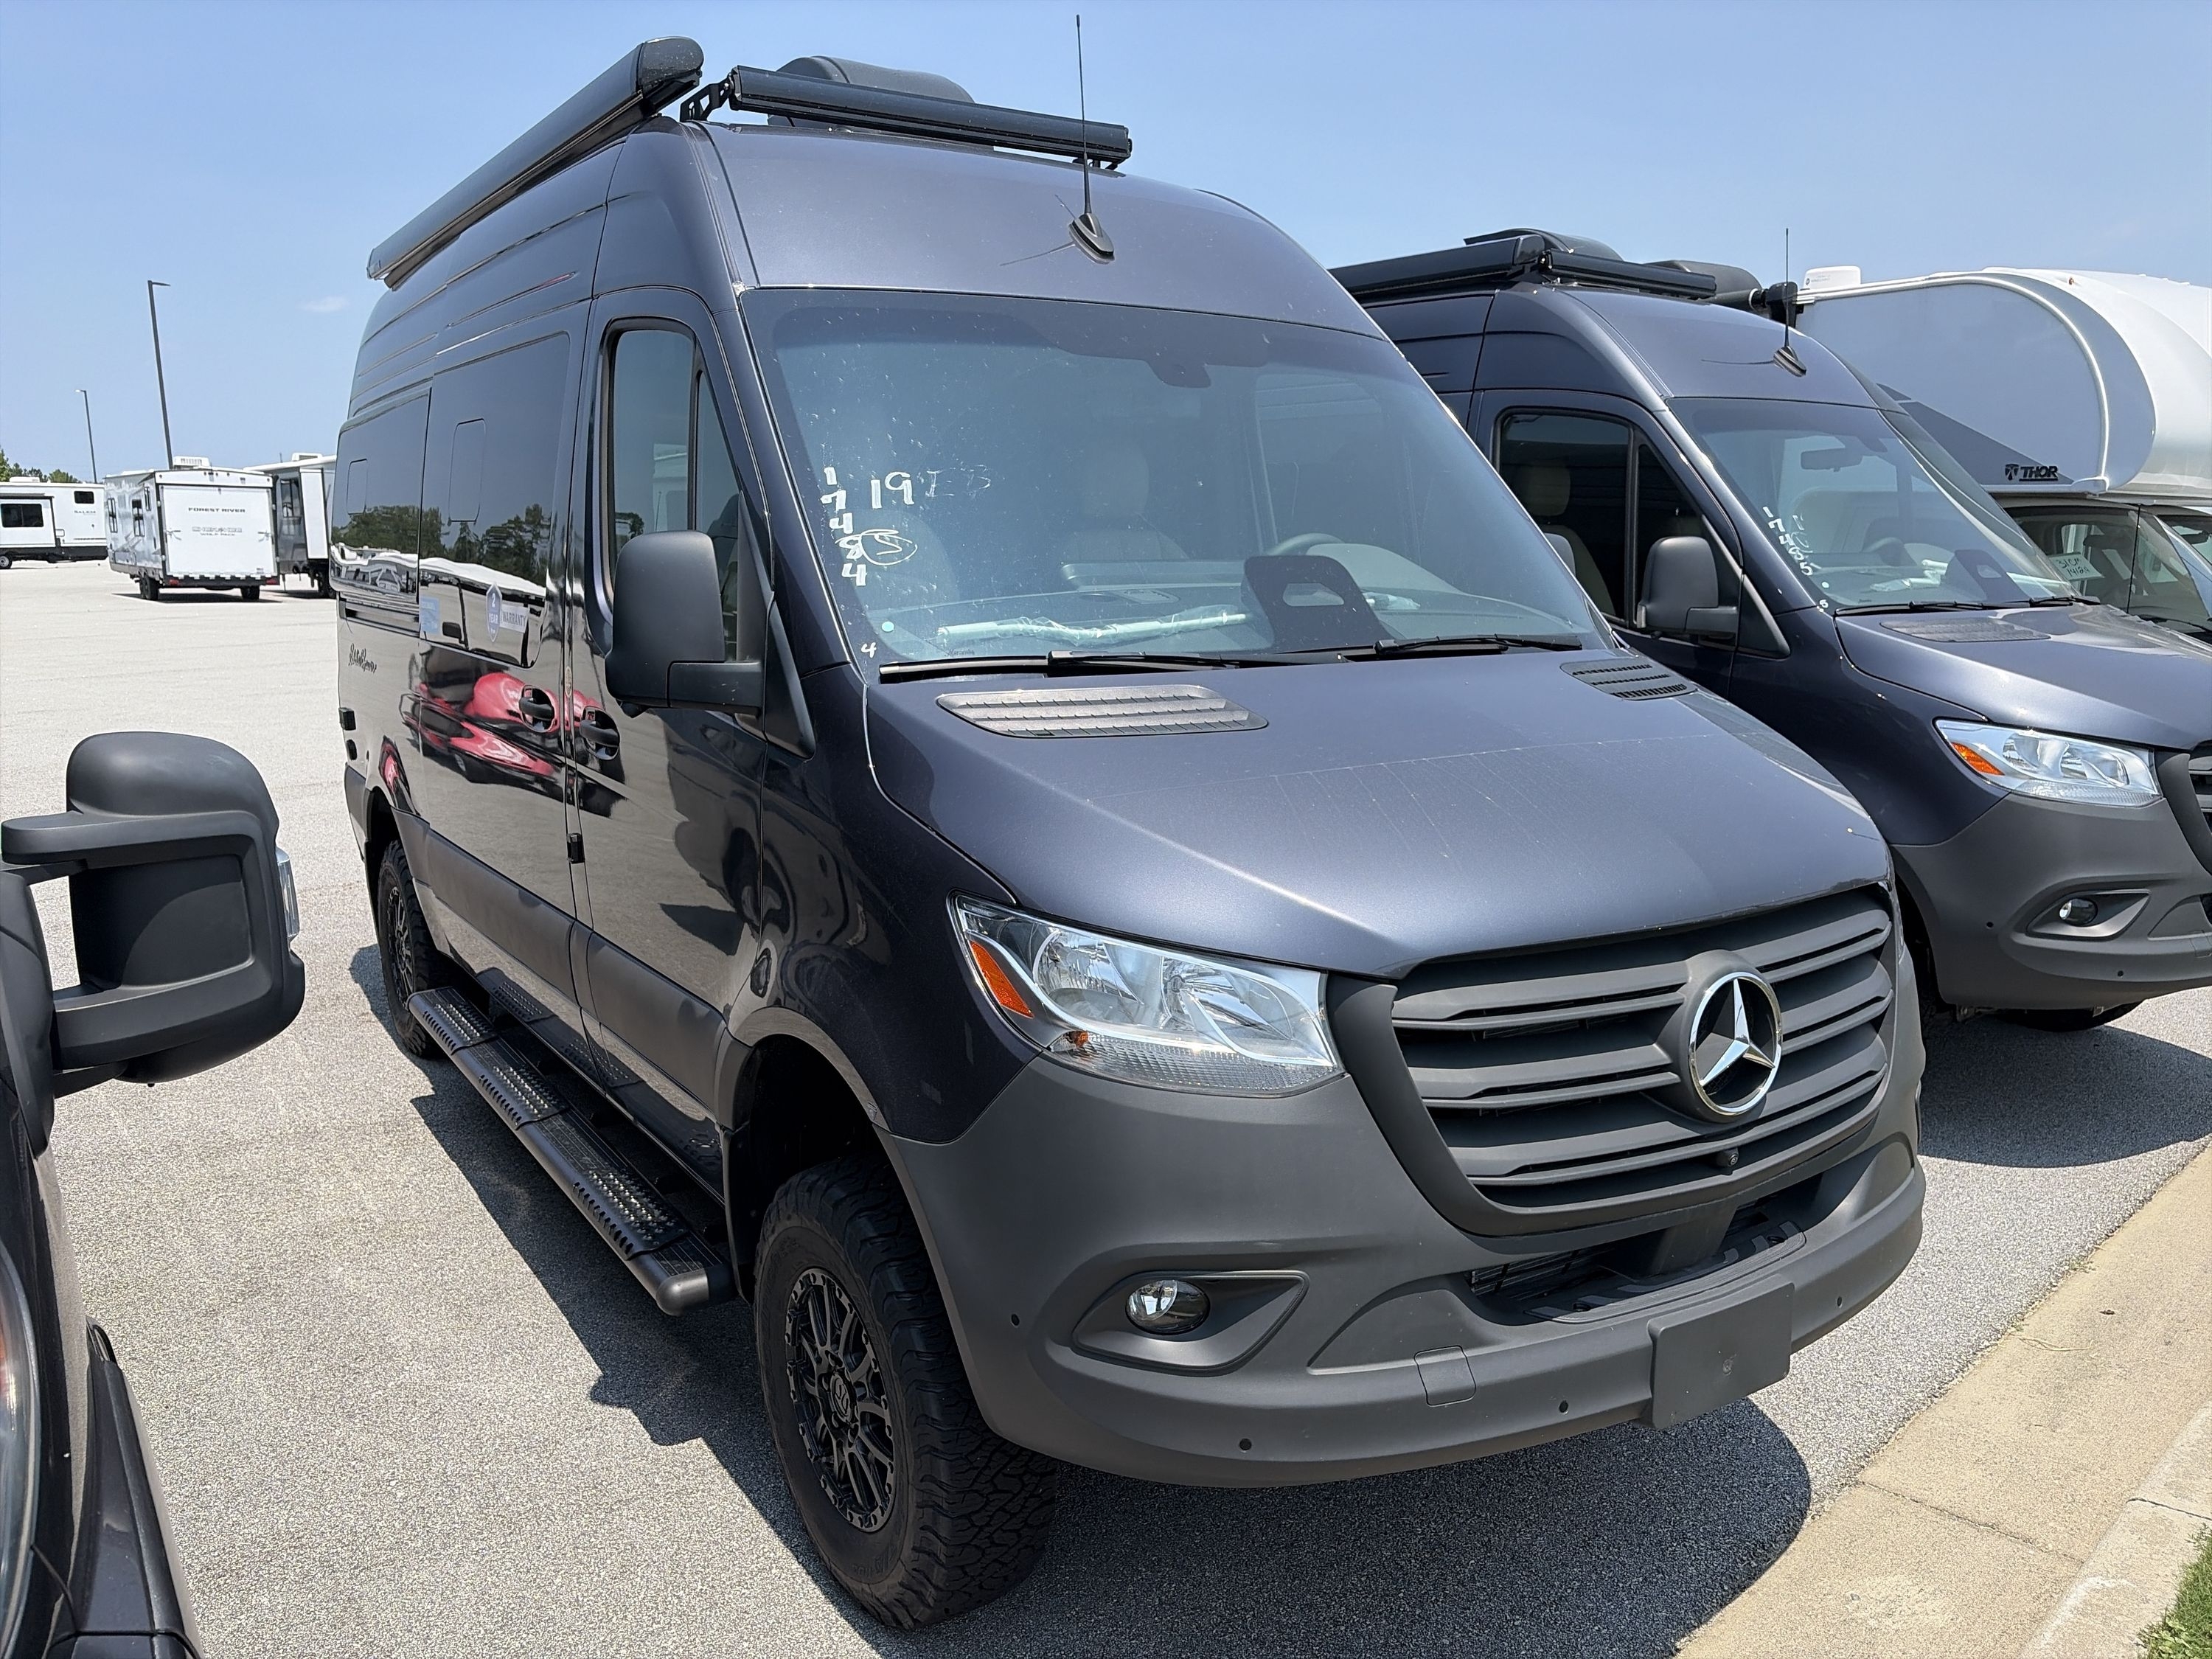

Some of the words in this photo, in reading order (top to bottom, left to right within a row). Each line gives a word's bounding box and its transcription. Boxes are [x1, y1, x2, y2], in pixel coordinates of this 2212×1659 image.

[2020, 466, 2058, 479] THOR
[870, 471, 915, 509] 19
[491, 592, 496, 608] 2
[502, 611, 526, 627] WARRANTY
[860, 642, 877, 658] 4
